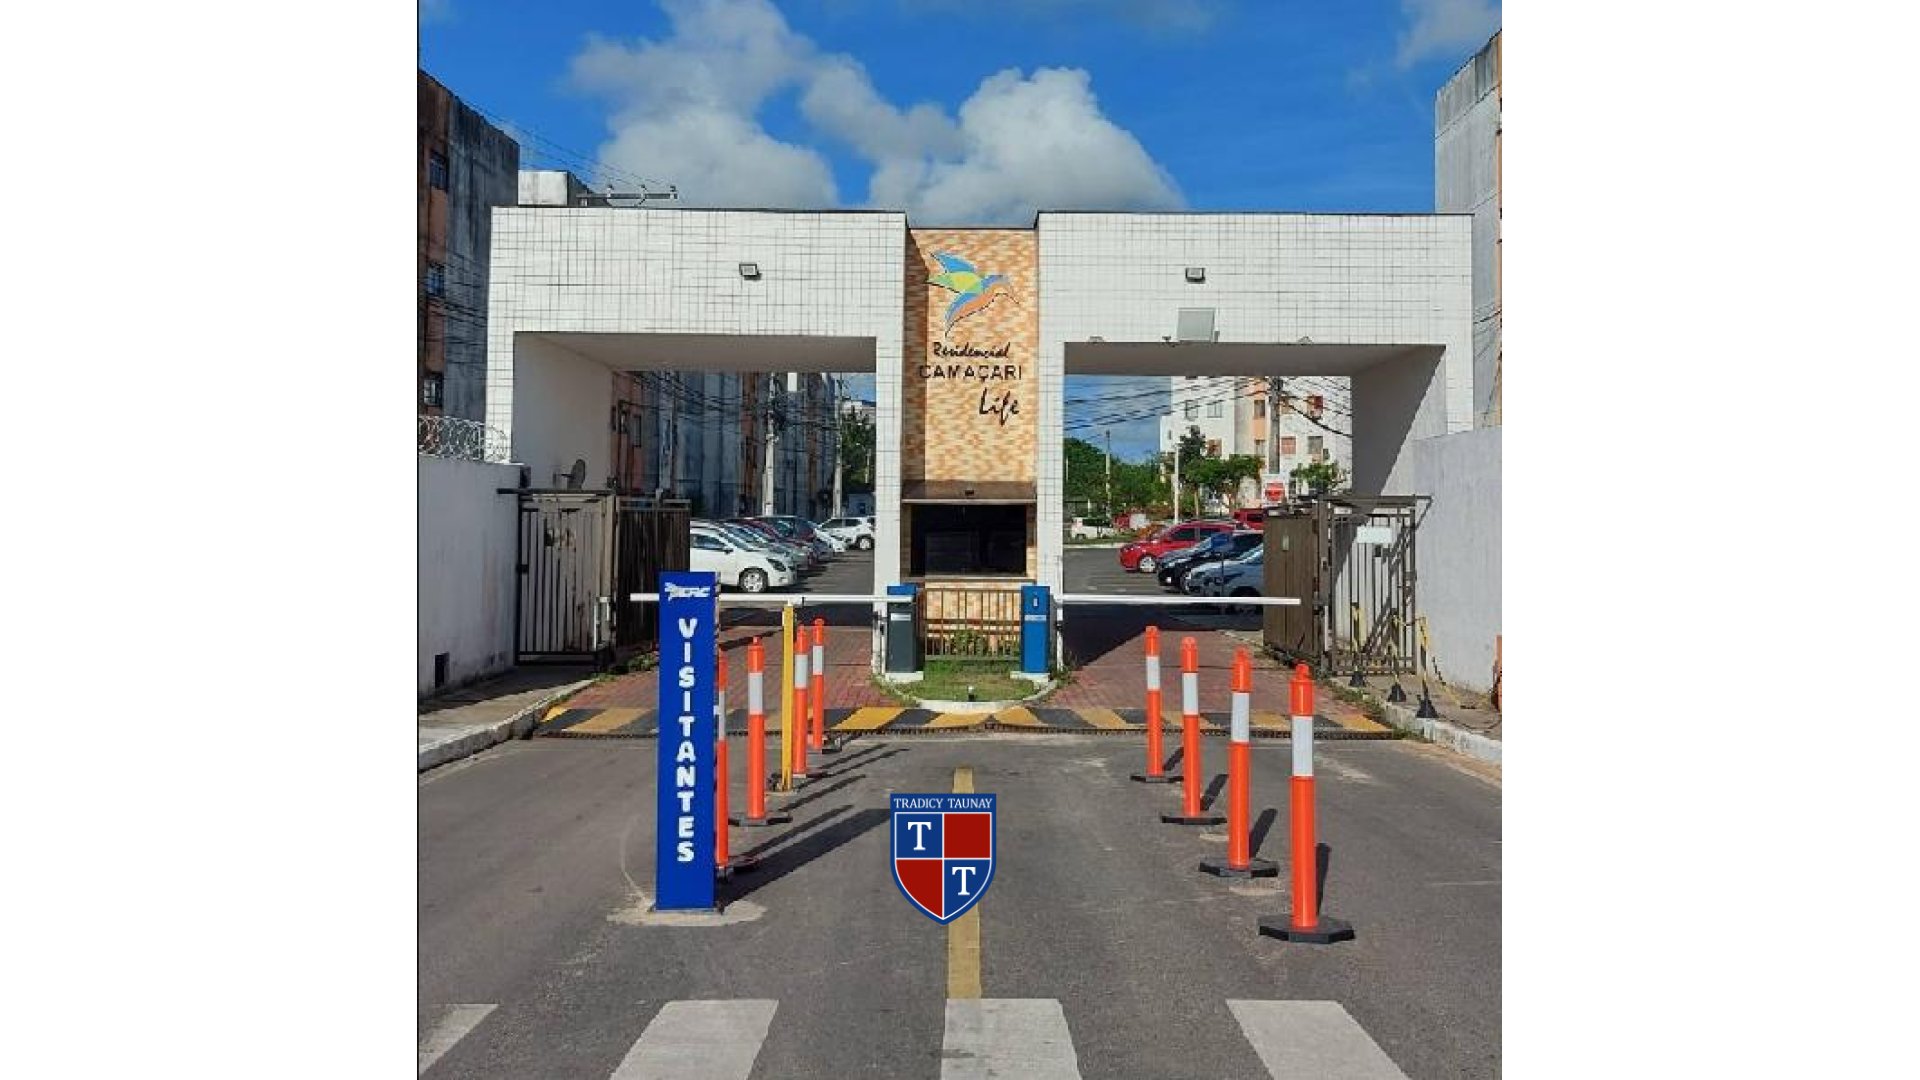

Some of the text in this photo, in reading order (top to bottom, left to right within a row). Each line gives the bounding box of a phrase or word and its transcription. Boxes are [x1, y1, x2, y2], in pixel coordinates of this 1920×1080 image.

[933, 342, 1010, 358] Residencial
[919, 365, 1022, 382] CAMAÇARI
[979, 387, 1020, 427] Life
[676, 618, 698, 862] VISITANTES
